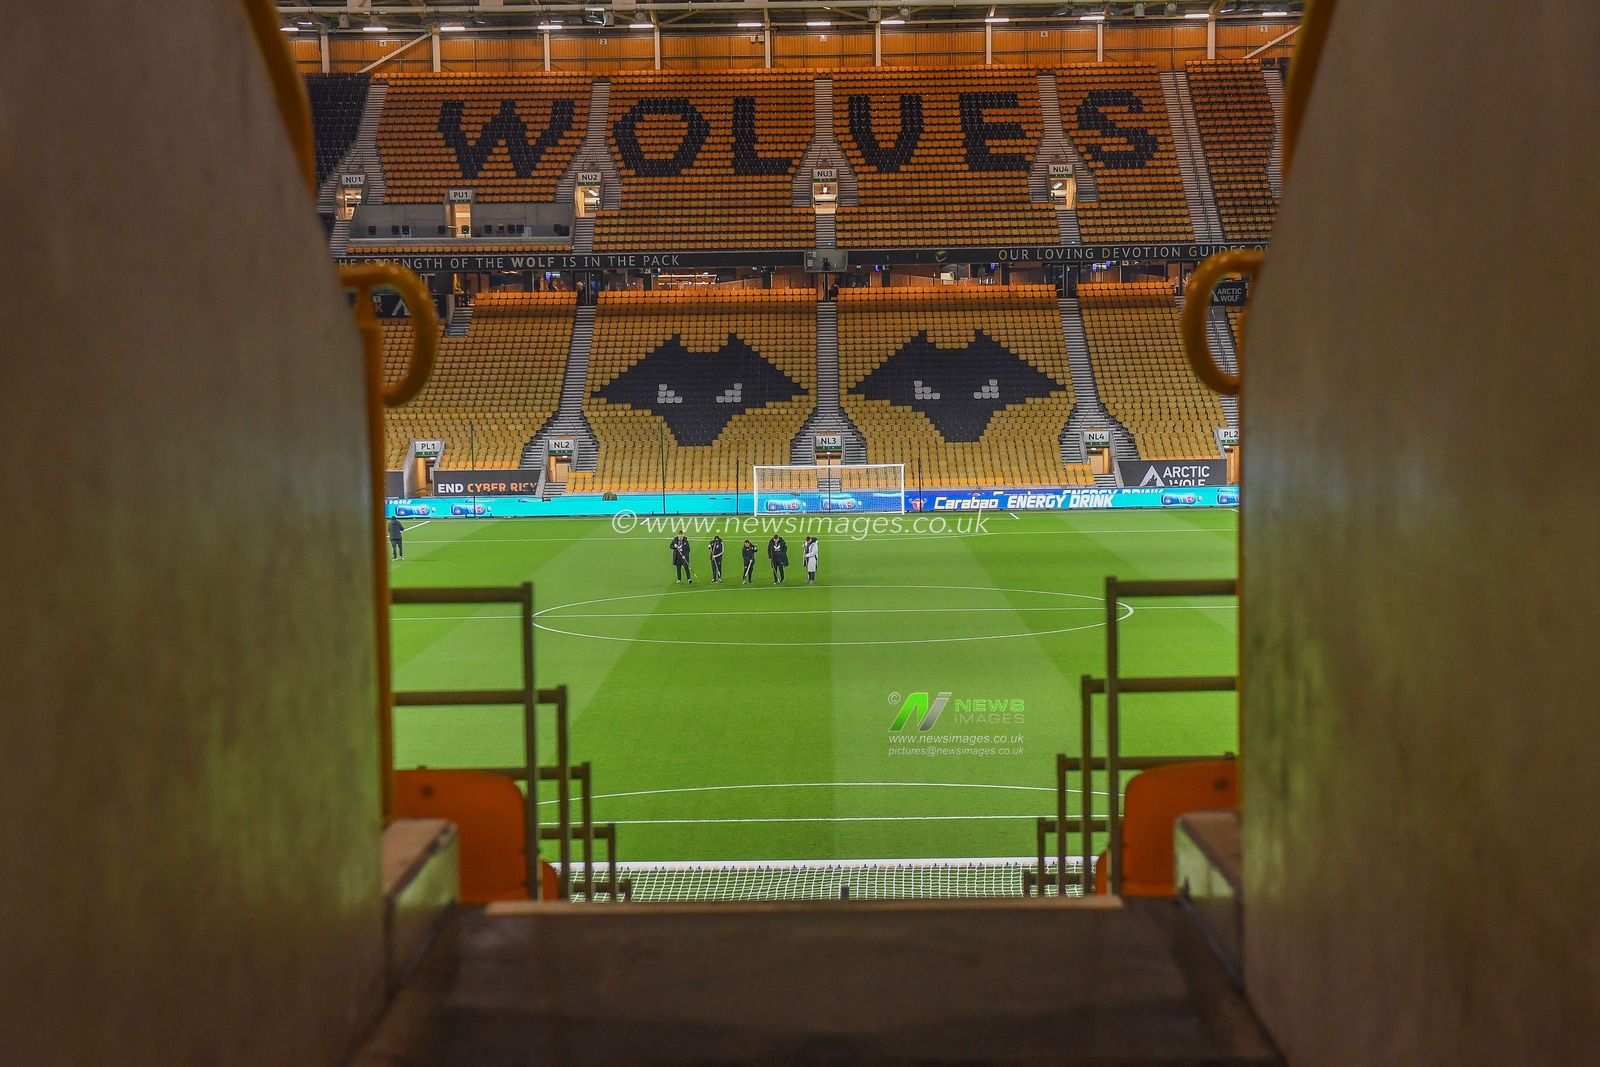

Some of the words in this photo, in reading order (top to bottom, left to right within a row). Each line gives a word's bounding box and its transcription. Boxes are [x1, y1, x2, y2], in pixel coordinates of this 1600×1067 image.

[438, 89, 1160, 179] WOLVES
[998, 249, 1029, 261] OUR
[1037, 248, 1094, 260] LOVING
[1102, 246, 1181, 259] DEVOTION
[450, 257, 468, 269] OF
[476, 257, 504, 269] THE
[511, 256, 555, 268] WOLF
[562, 256, 577, 267] IS
[584, 255, 600, 267] IN
[608, 255, 635, 266] THE
[643, 254, 679, 266] PACK
[1223, 430, 1239, 438] PL2
[553, 441, 570, 449] NL2
[820, 437, 837, 445] NL3
[1163, 465, 1210, 478] ARCTIC
[437, 483, 464, 493] END
[467, 482, 507, 492] CYBER
[933, 496, 999, 510] Carabao
[1007, 494, 1067, 509] ENERGY
[1068, 494, 1115, 508] DRINK
